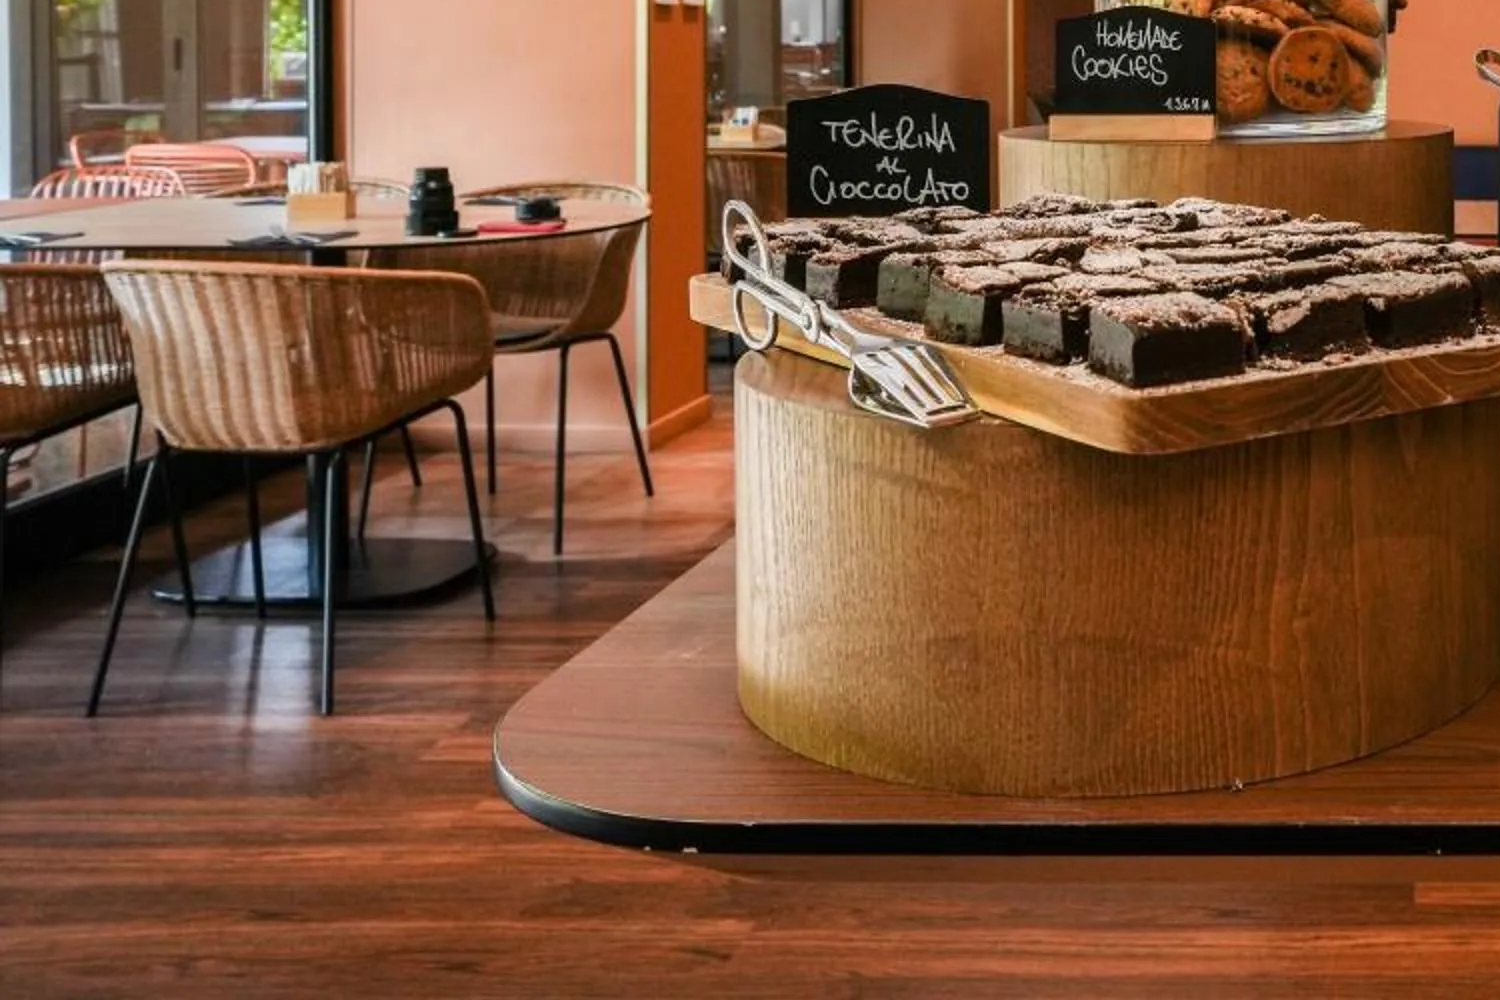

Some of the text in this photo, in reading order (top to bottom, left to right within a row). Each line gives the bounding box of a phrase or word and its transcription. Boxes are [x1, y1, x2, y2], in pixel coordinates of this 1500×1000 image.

[1095, 17, 1183, 51] HOMEMADE
[1071, 44, 1169, 86] COOKIES
[876, 155, 907, 175] AL
